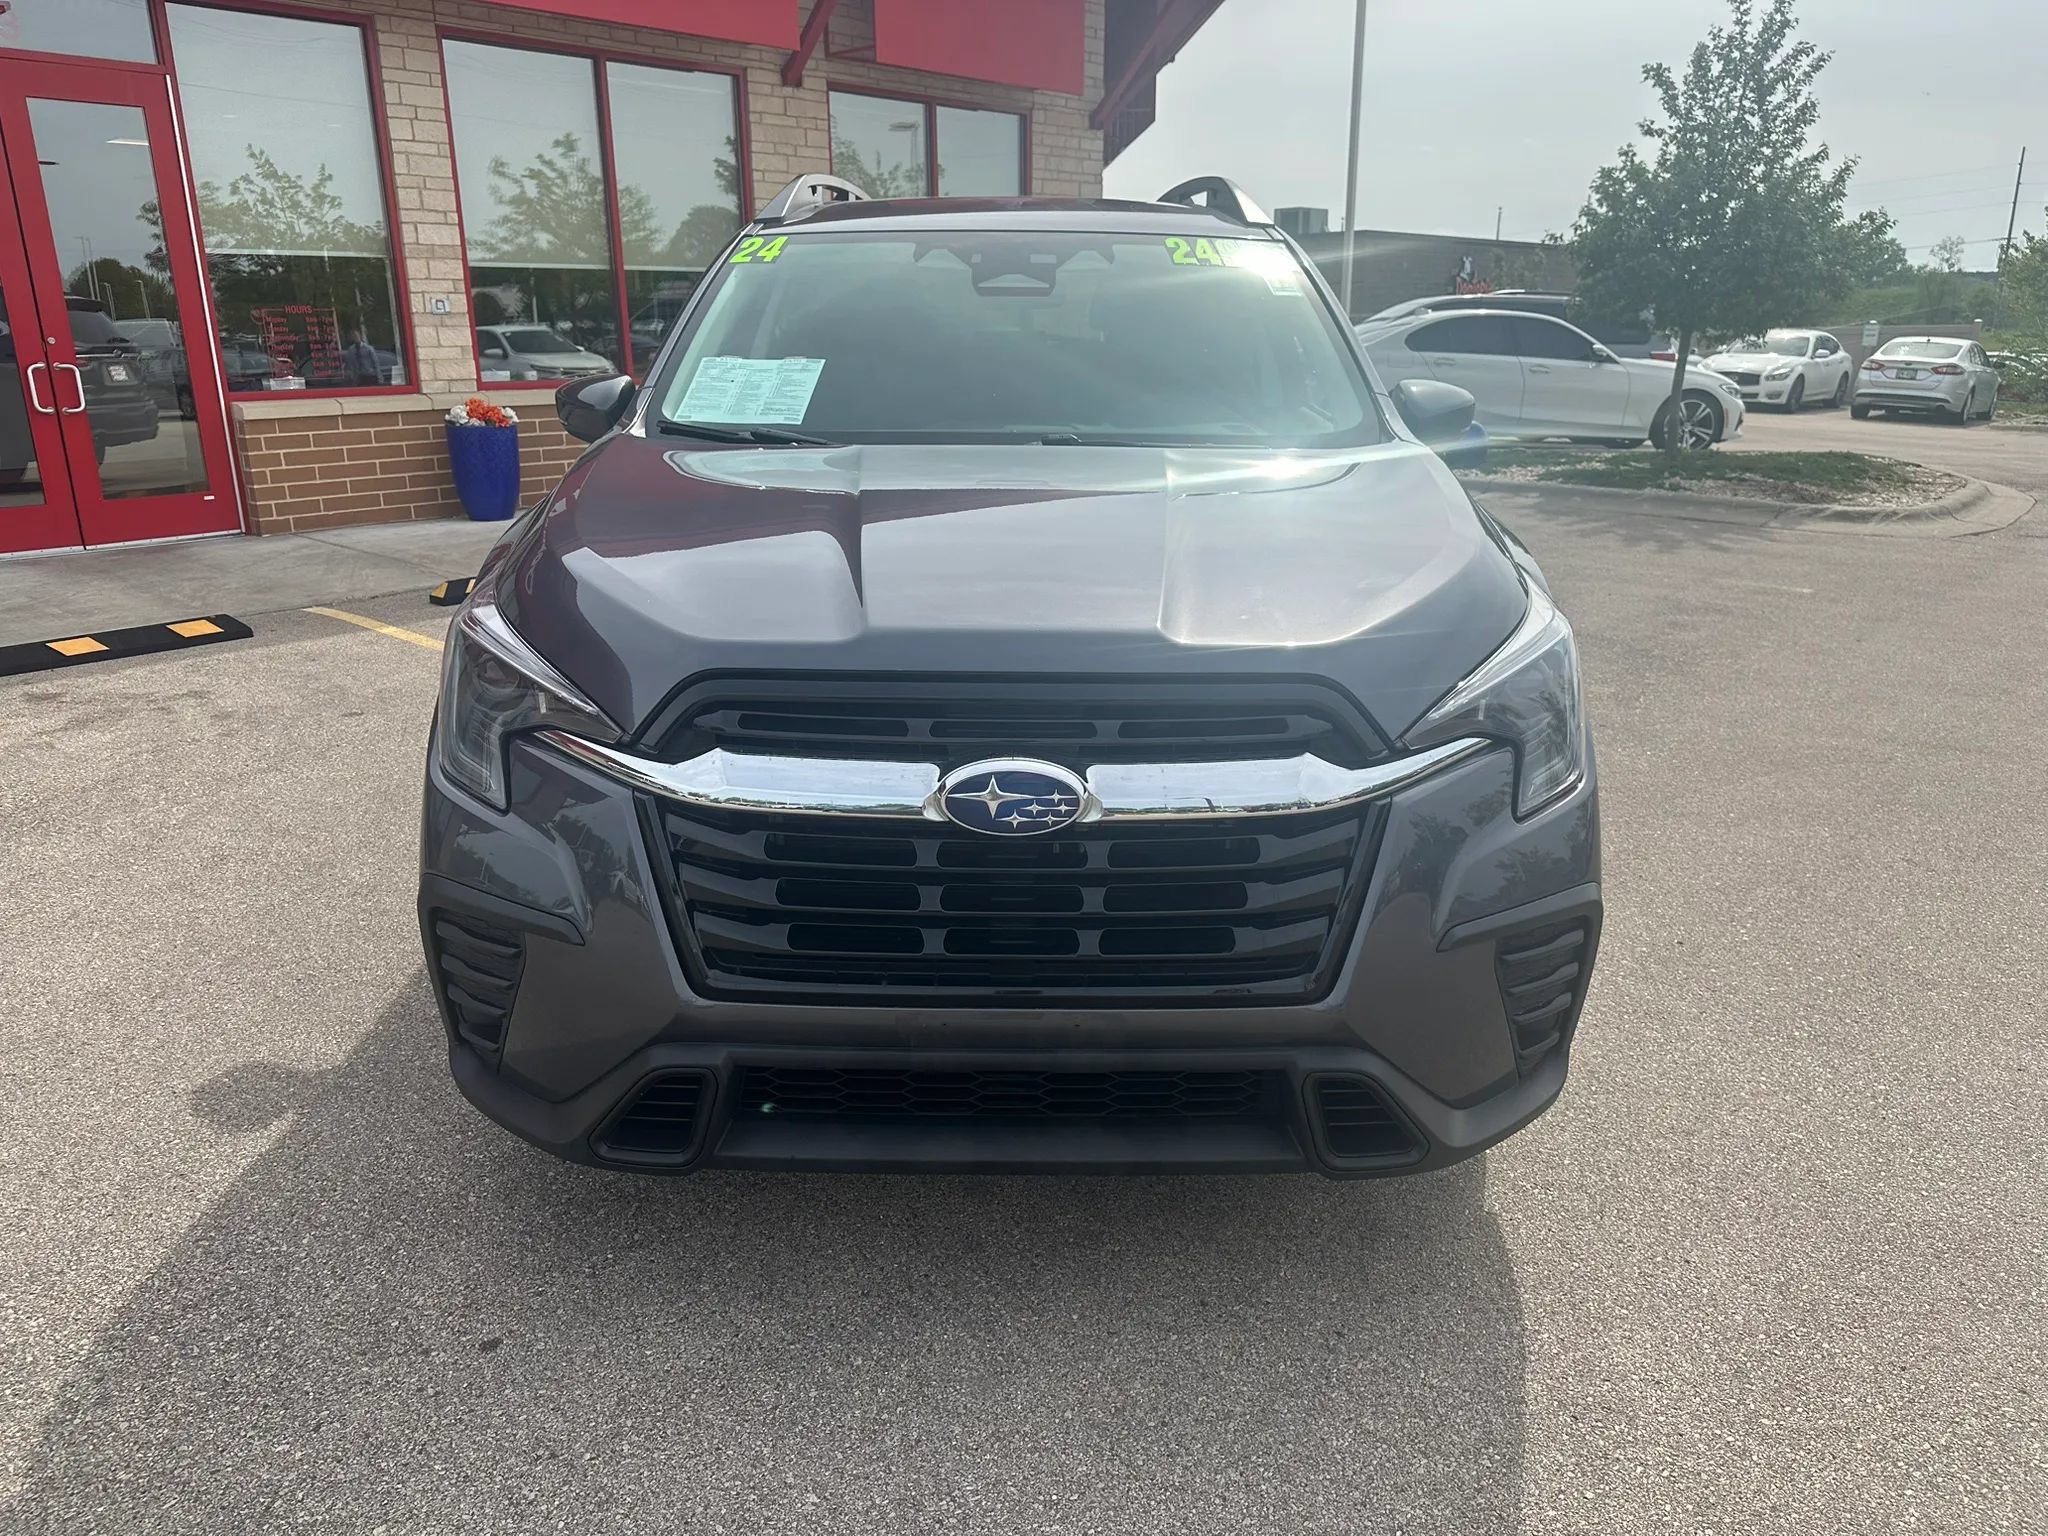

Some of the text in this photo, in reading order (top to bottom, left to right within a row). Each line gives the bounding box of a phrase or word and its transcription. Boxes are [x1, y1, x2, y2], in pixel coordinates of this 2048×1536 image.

[729, 235, 788, 263] 24
[1164, 237, 1224, 266] 24
[284, 305, 313, 314] HOURS
